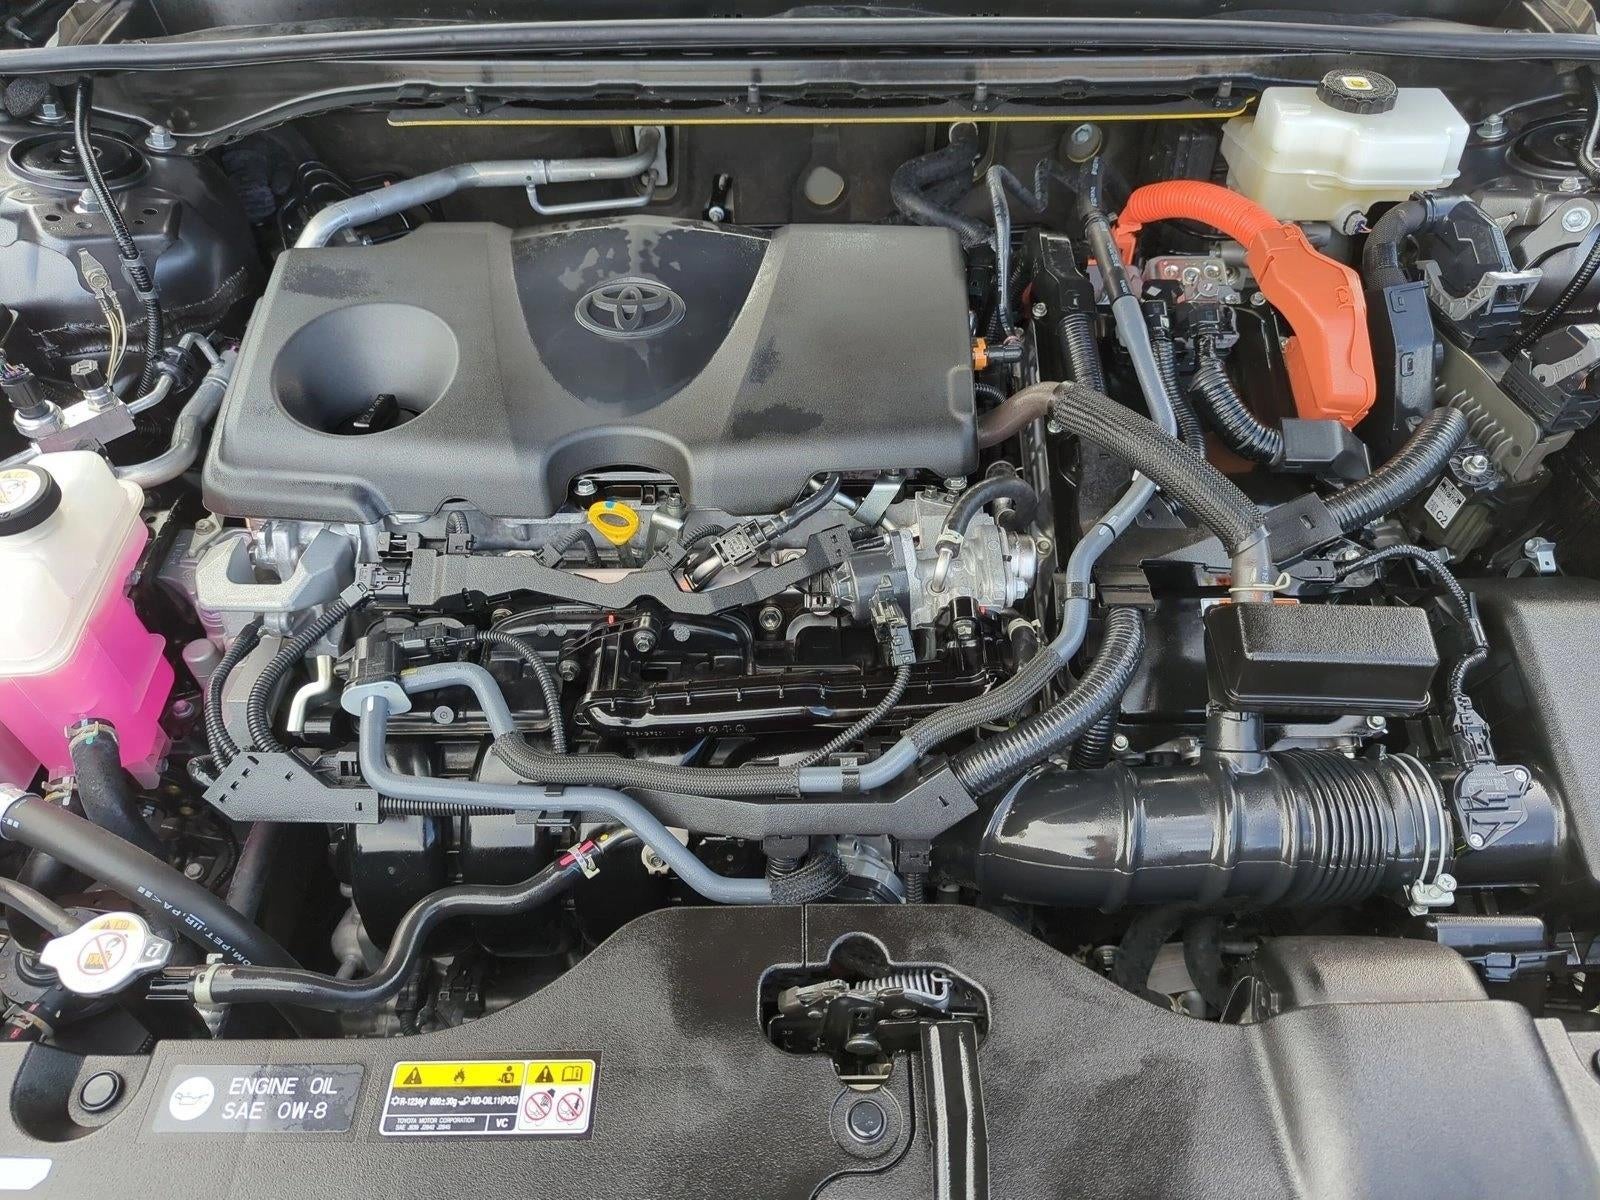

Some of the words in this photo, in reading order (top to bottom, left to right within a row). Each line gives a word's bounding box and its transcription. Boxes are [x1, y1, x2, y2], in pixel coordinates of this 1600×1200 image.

[1436, 511, 1448, 525] C2
[228, 1077, 299, 1095] ENGINE
[309, 1077, 338, 1095] OIL
[221, 1102, 265, 1119] SAE
[277, 1102, 327, 1119] 0W-8
[495, 1118, 509, 1128] VC
